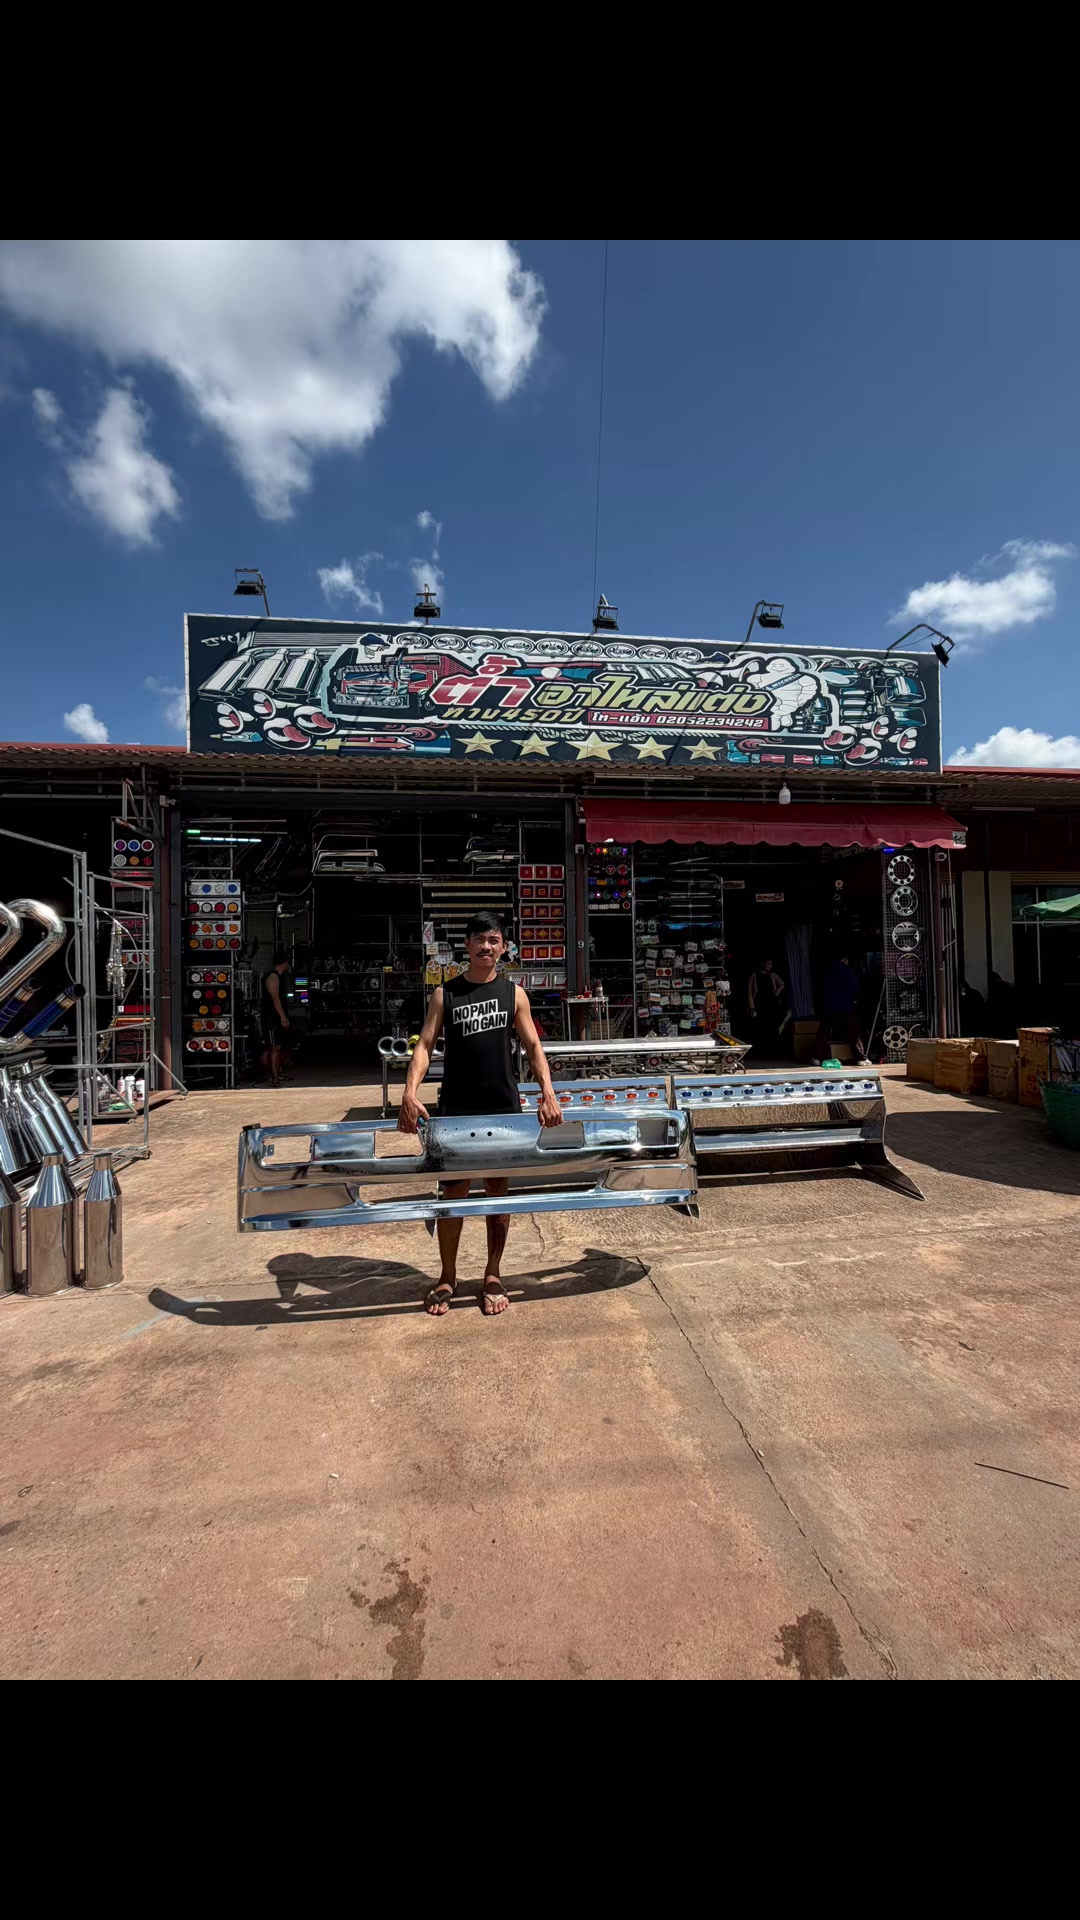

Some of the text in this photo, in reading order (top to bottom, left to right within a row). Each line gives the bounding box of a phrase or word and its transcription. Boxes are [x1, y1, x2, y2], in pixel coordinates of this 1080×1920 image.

[656, 715, 764, 728] 02052234242
[577, 940, 585, 948] 9
[454, 1000, 497, 1022] NO PAIN
[464, 1012, 506, 1035] NO GAIN
